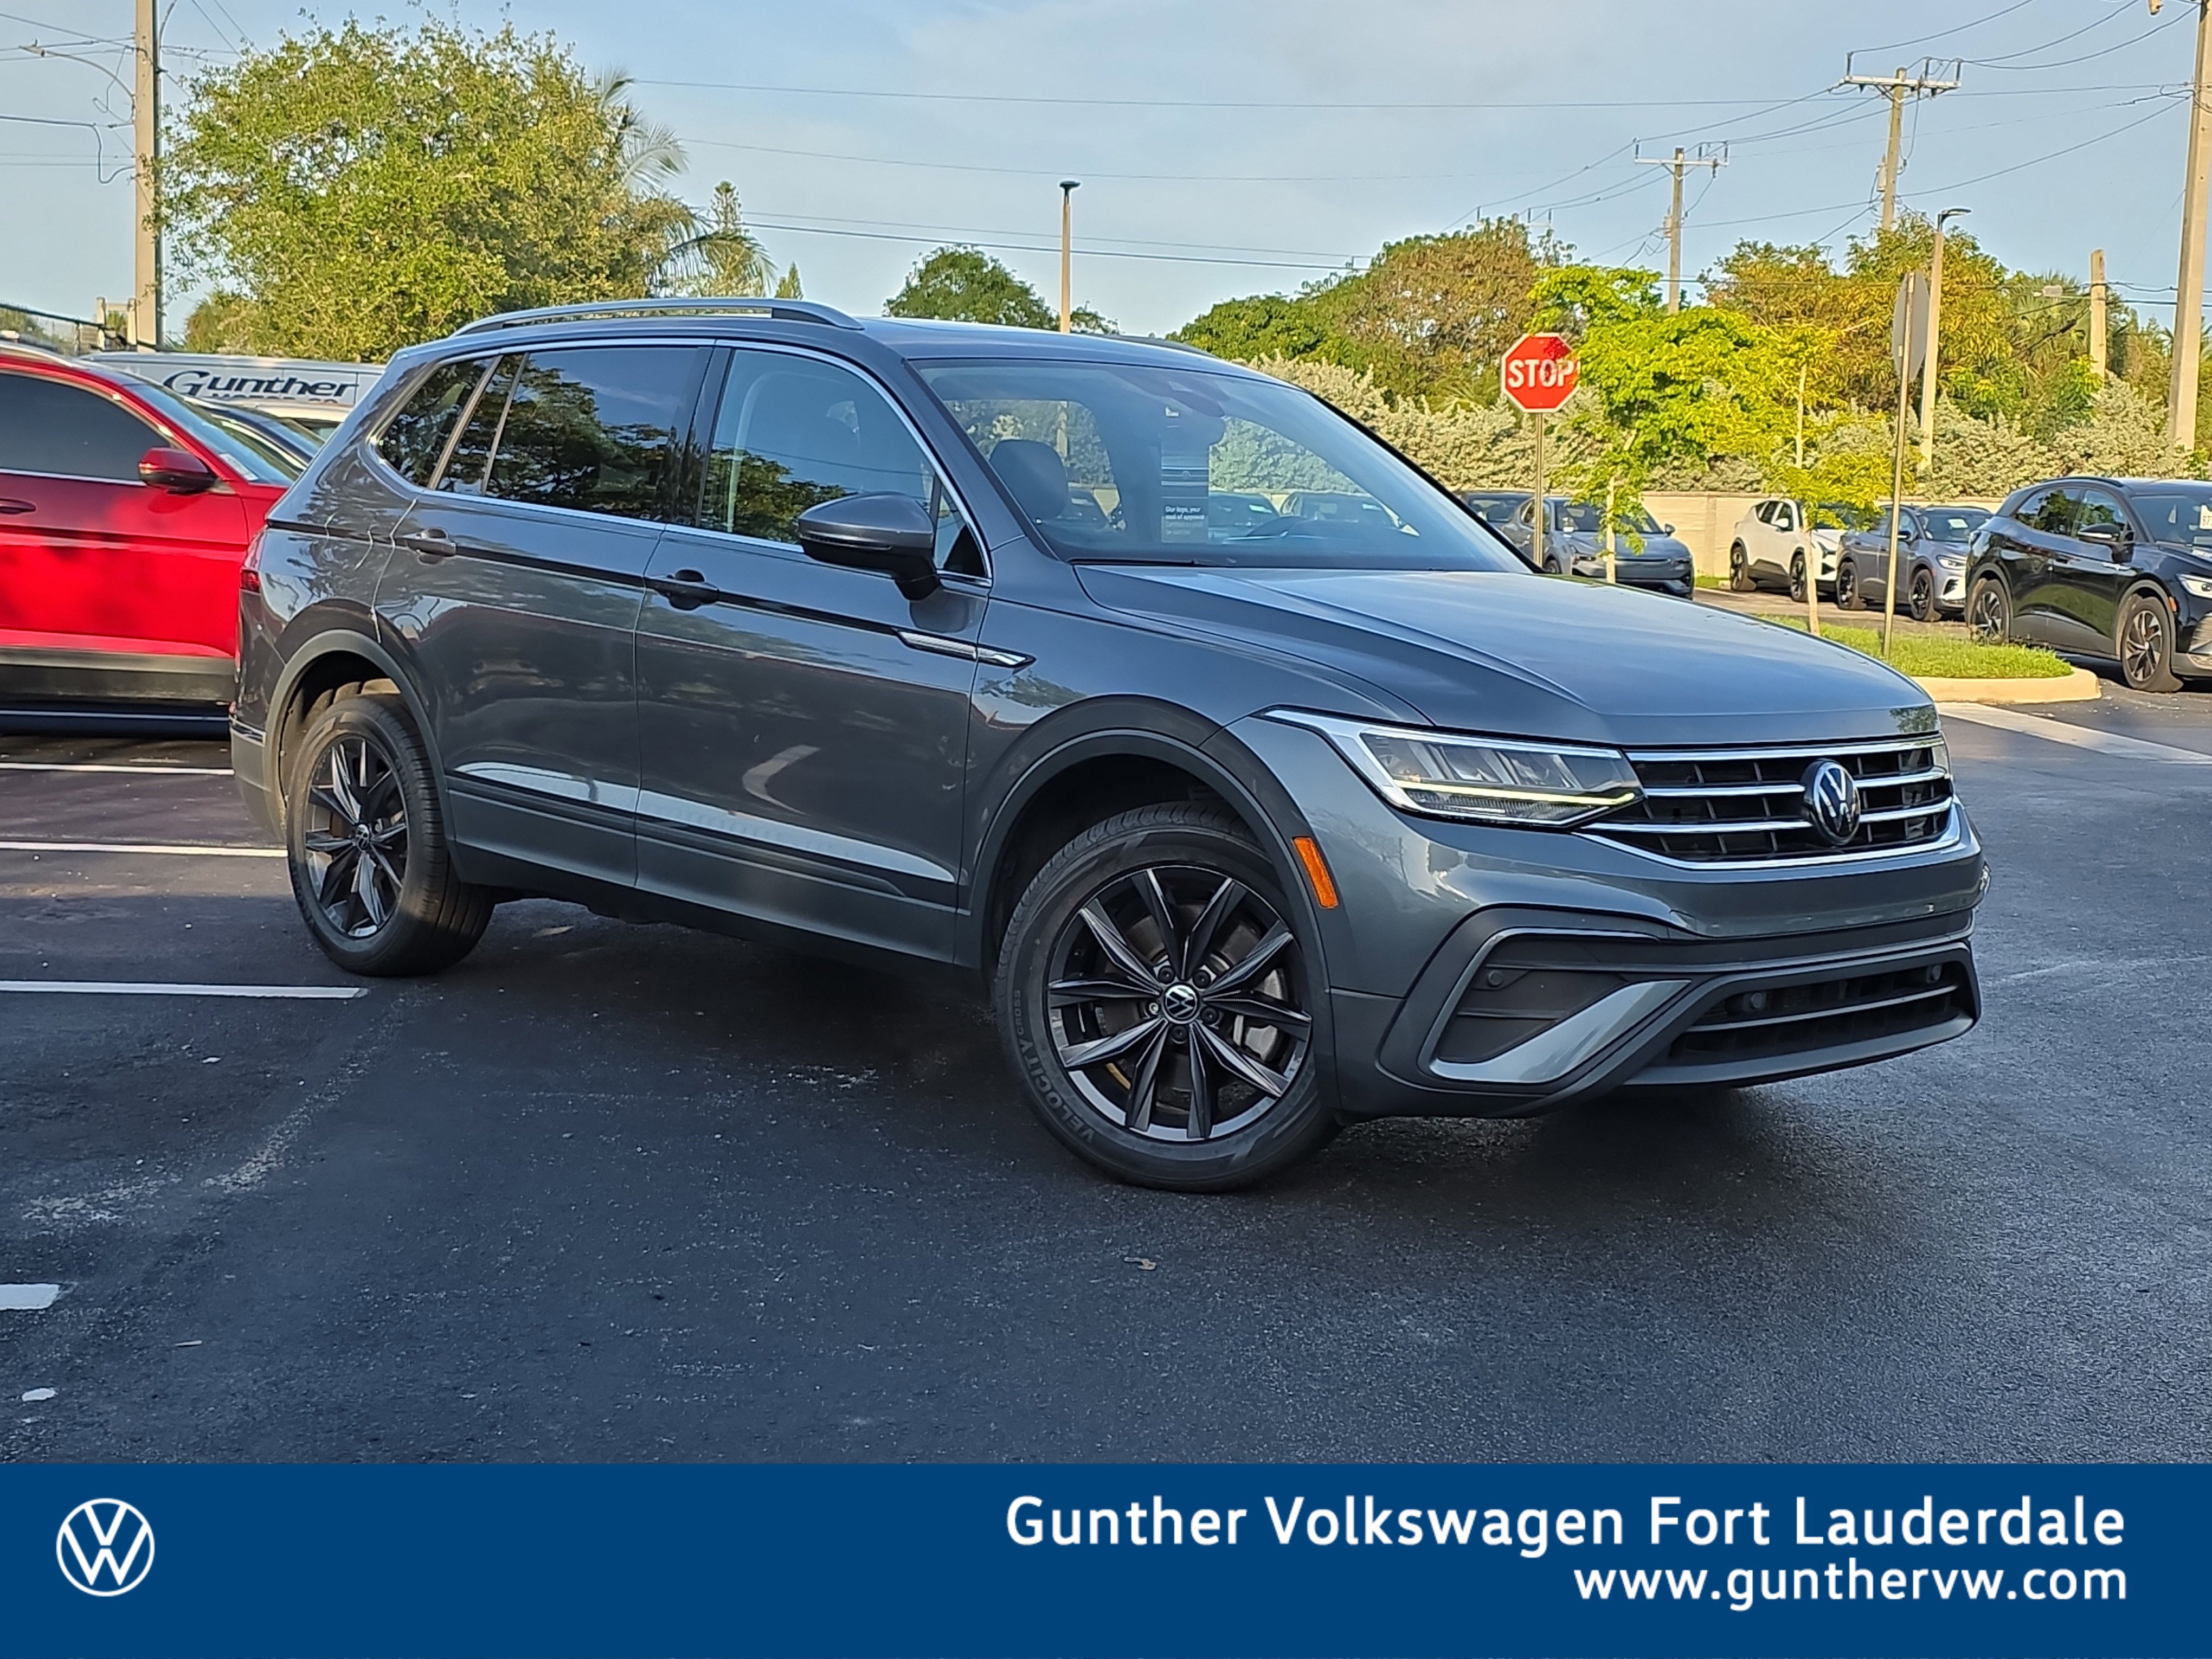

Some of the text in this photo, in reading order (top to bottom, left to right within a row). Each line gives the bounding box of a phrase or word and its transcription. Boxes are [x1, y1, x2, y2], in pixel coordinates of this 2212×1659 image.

[163, 370, 359, 397] Gunther
[1507, 358, 1574, 388] STOP
[1013, 989, 1095, 1143] VELOCITY CROSS
